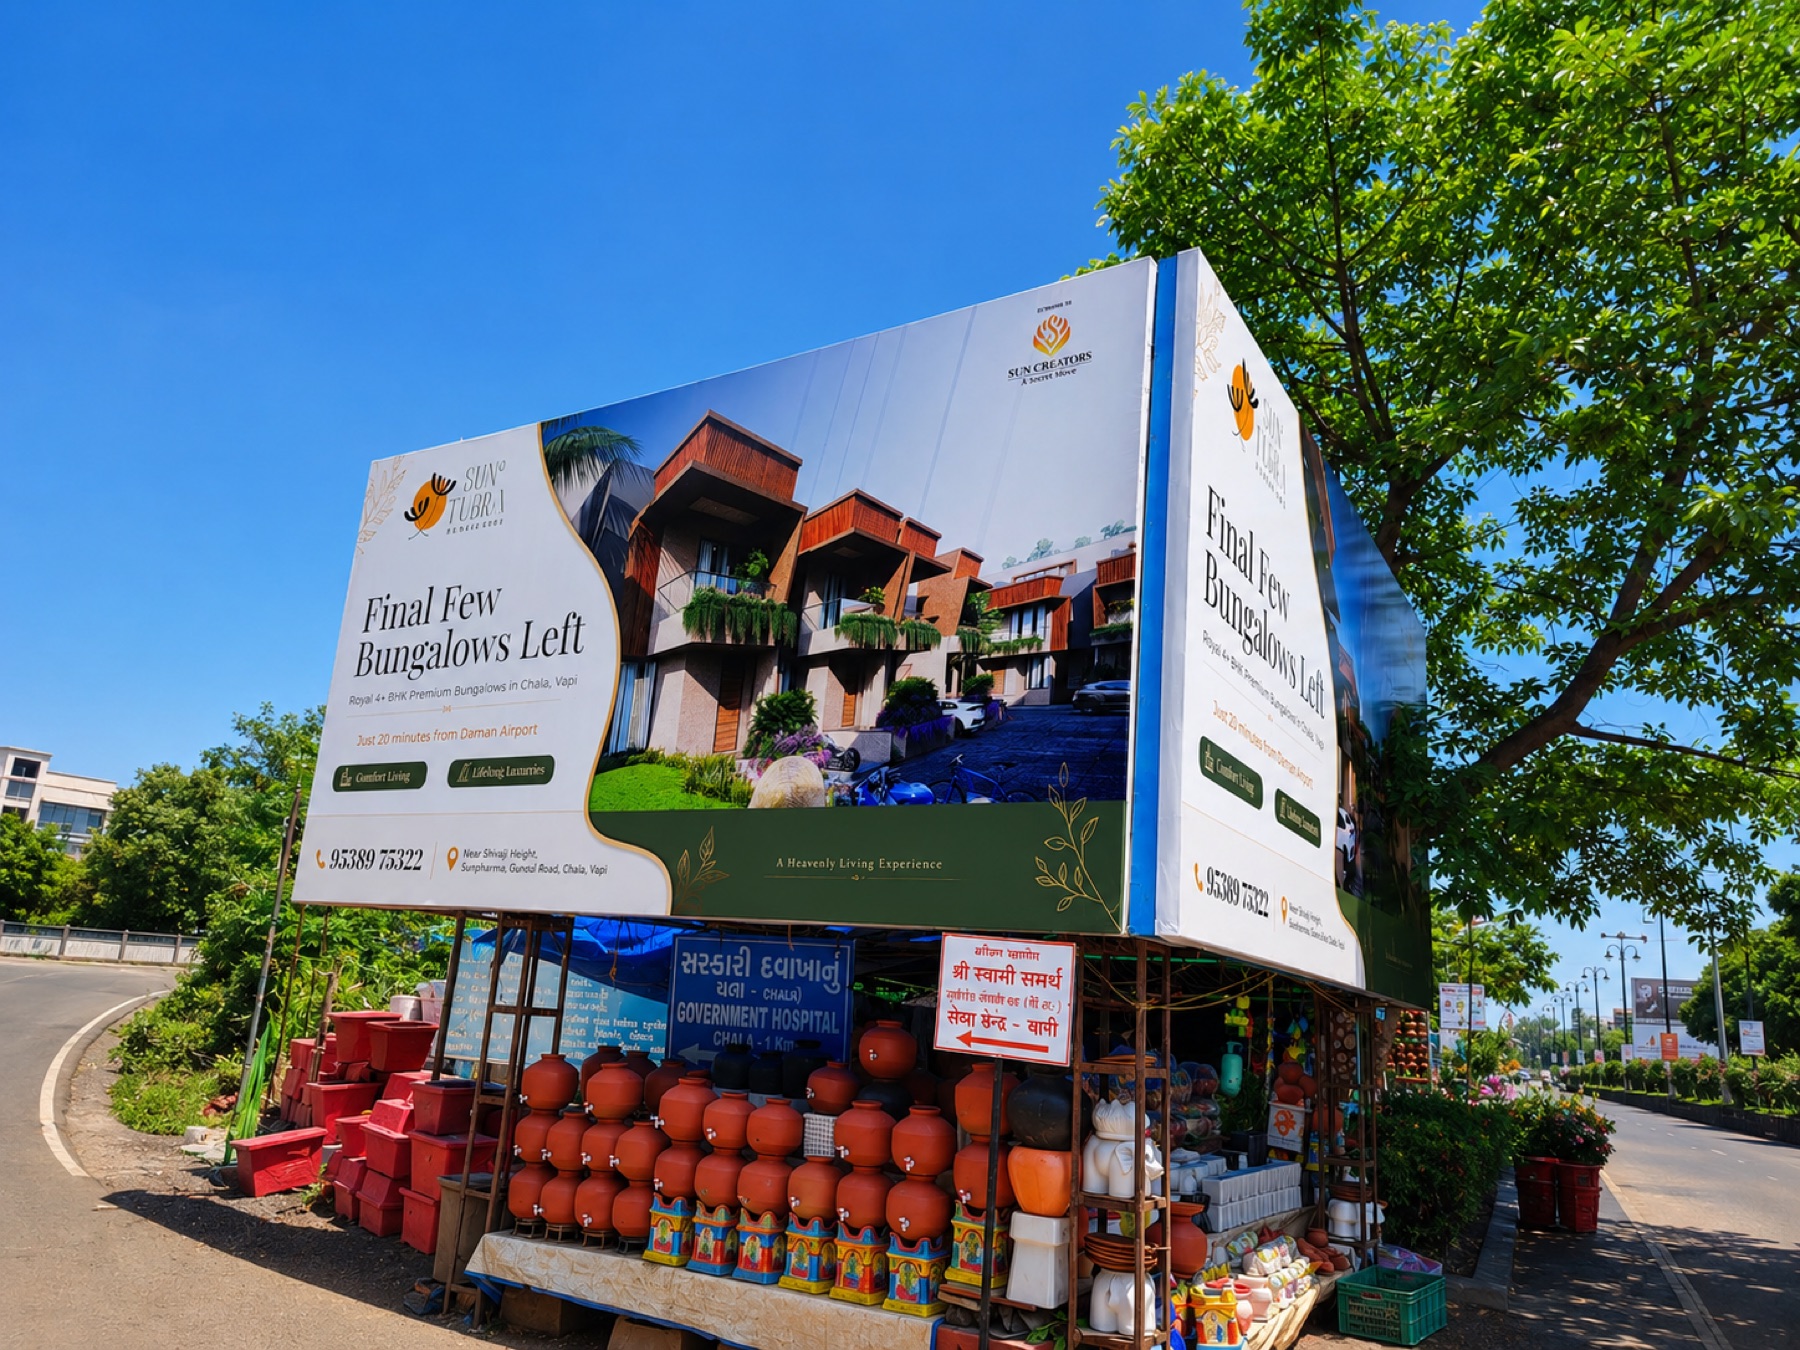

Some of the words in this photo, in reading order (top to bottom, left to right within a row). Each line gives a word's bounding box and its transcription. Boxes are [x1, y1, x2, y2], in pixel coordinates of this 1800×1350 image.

[1008, 365, 1031, 378] SUN
[1033, 351, 1092, 370] CREATORS
[1205, 484, 1254, 585] Final
[1258, 547, 1290, 623] Few
[362, 586, 435, 633] Final
[440, 584, 502, 623] Few
[354, 628, 511, 680] Bungalows
[519, 611, 587, 659] Left
[1203, 550, 1297, 690] Bungalows
[1299, 654, 1325, 719] Left
[349, 694, 373, 707] Royal
[375, 693, 385, 702] 4+
[388, 691, 407, 702] BHK
[409, 687, 452, 700] Premium
[454, 682, 507, 697] Bungalows
[509, 680, 518, 691] in
[520, 678, 552, 691] Chala,
[555, 675, 578, 688] Vapi
[356, 734, 376, 747] Just
[377, 733, 390, 746] 20
[392, 730, 431, 744] minutes
[433, 728, 458, 742] from
[460, 727, 497, 741] Daman
[500, 723, 539, 740] Airport
[329, 848, 375, 870] 95389
[378, 848, 424, 870] 75322
[463, 849, 481, 859] Near
[776, 858, 784, 867] A
[787, 857, 836, 871] Heavenly
[839, 857, 875, 871] Living
[879, 857, 942, 871] Experience
[590, 864, 608, 876] Vapi
[1206, 866, 1240, 906] 95389
[681, 946, 751, 978] સરકારી
[952, 960, 970, 981] श्री
[973, 964, 1016, 985] स्वामी
[1021, 967, 1063, 990] समर्थ
[716, 981, 745, 999] ચલા
[677, 1001, 768, 1029] GOVERNMENT
[772, 1007, 839, 1034] HOSPITAL
